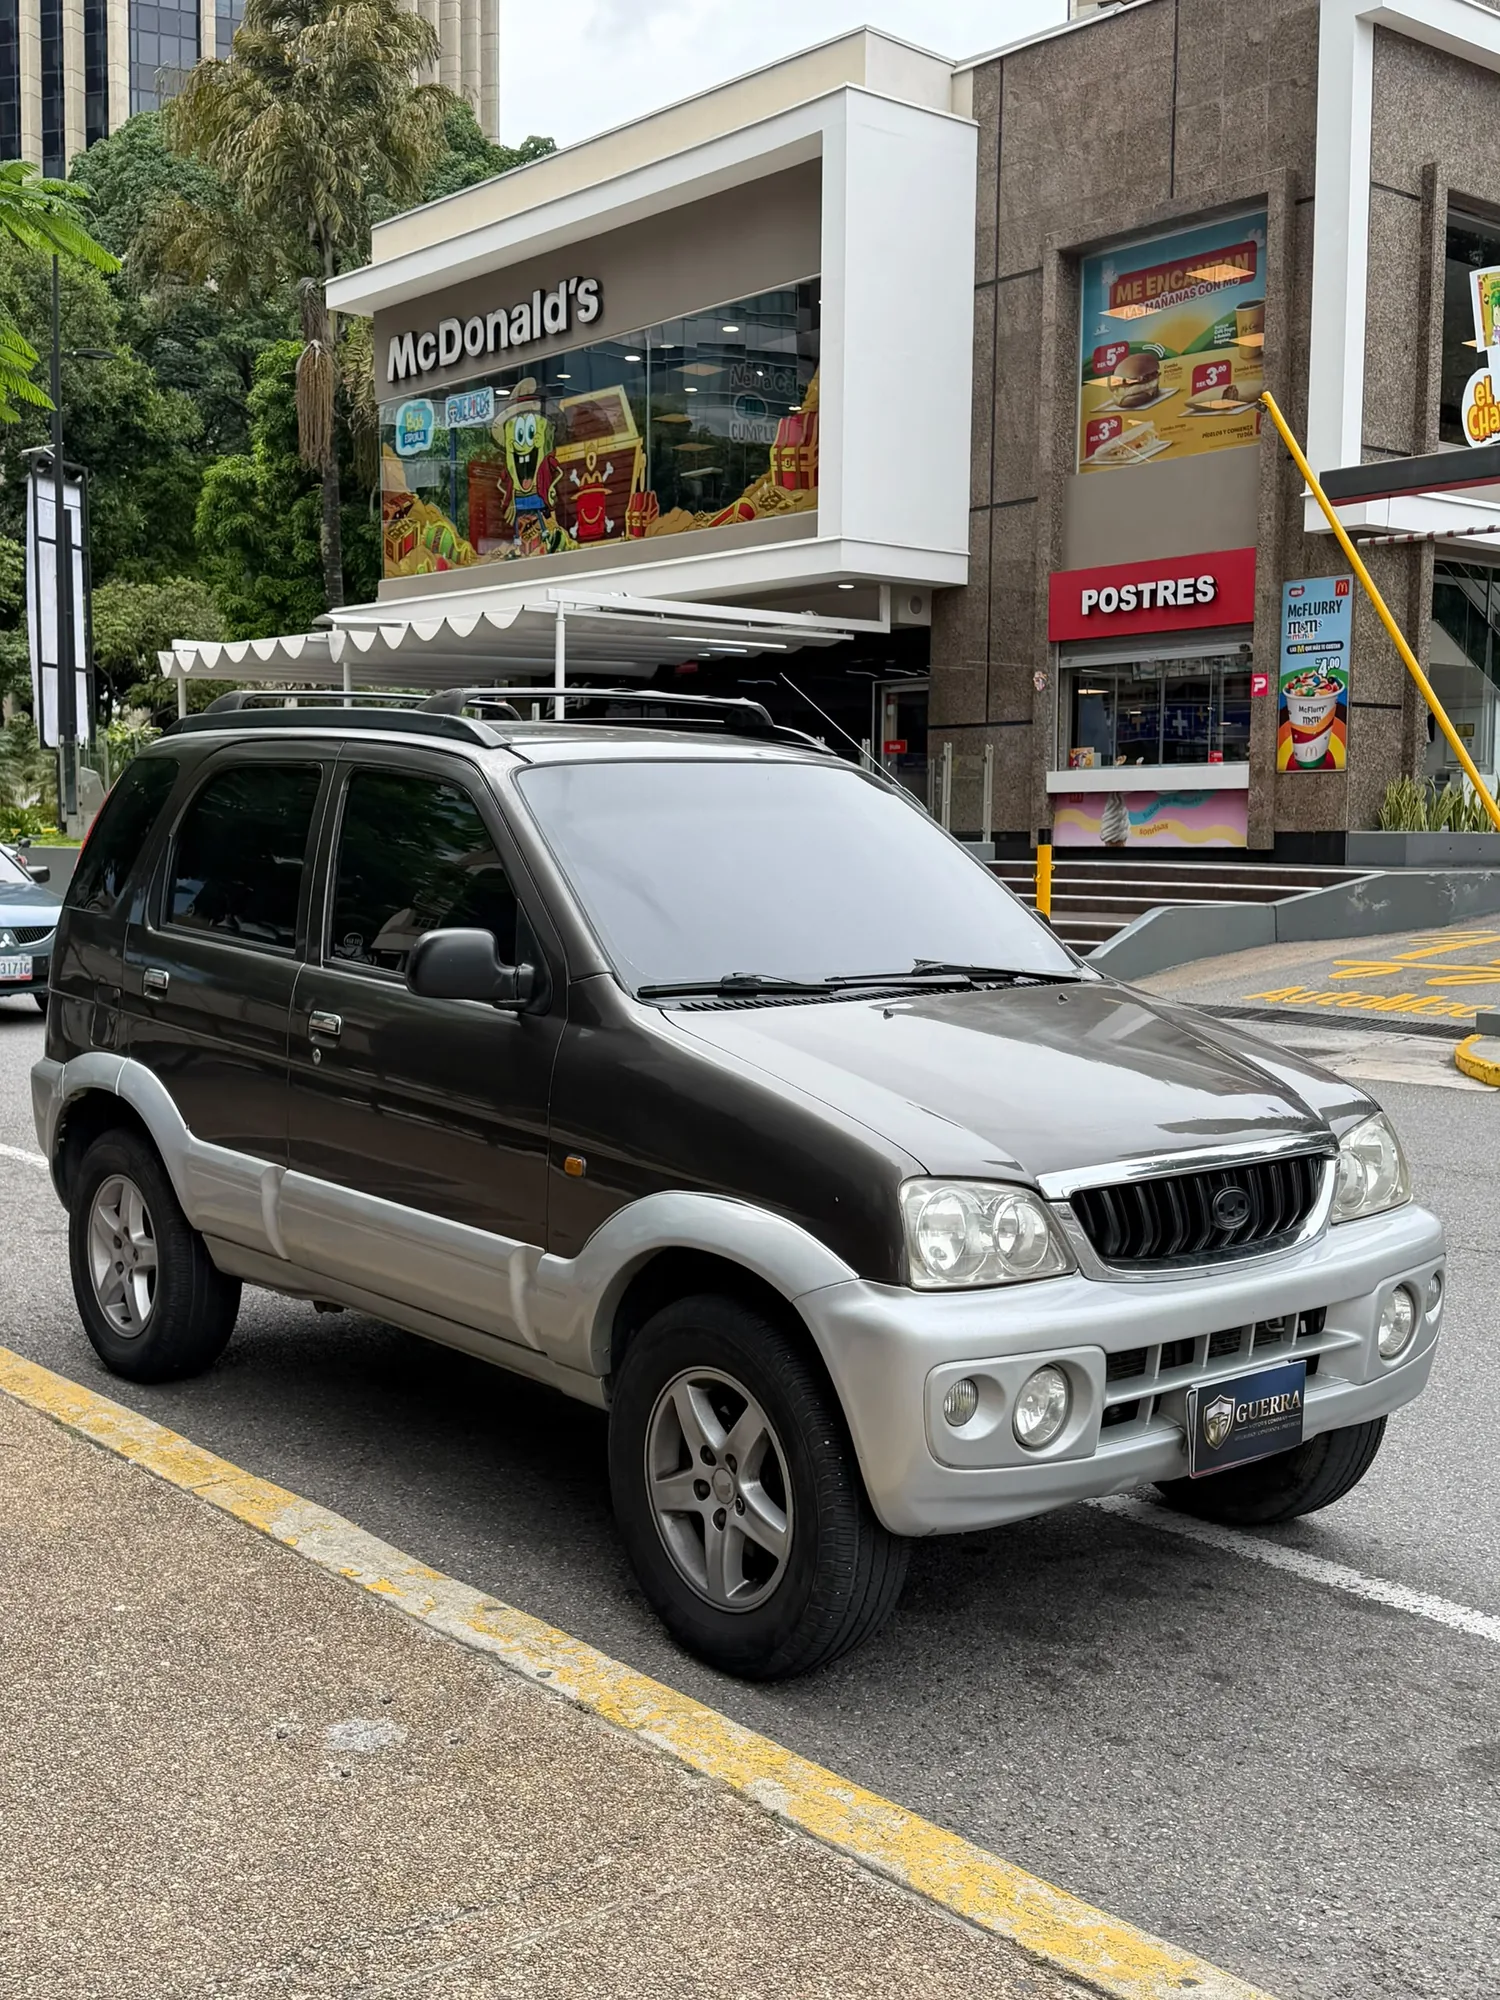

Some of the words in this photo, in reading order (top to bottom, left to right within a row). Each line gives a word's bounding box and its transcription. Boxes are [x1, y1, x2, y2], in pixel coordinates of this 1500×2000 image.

[1116, 279, 1143, 304] ME
[1146, 253, 1249, 295] ENCAN
[1144, 291, 1196, 315] MAÑANAS
[1198, 281, 1221, 296] CON
[387, 276, 600, 382] McDonald's
[1081, 575, 1216, 616] POSTRES
[1287, 599, 1343, 618] McFLURRY
[1237, 1390, 1302, 1423] GUERRA
